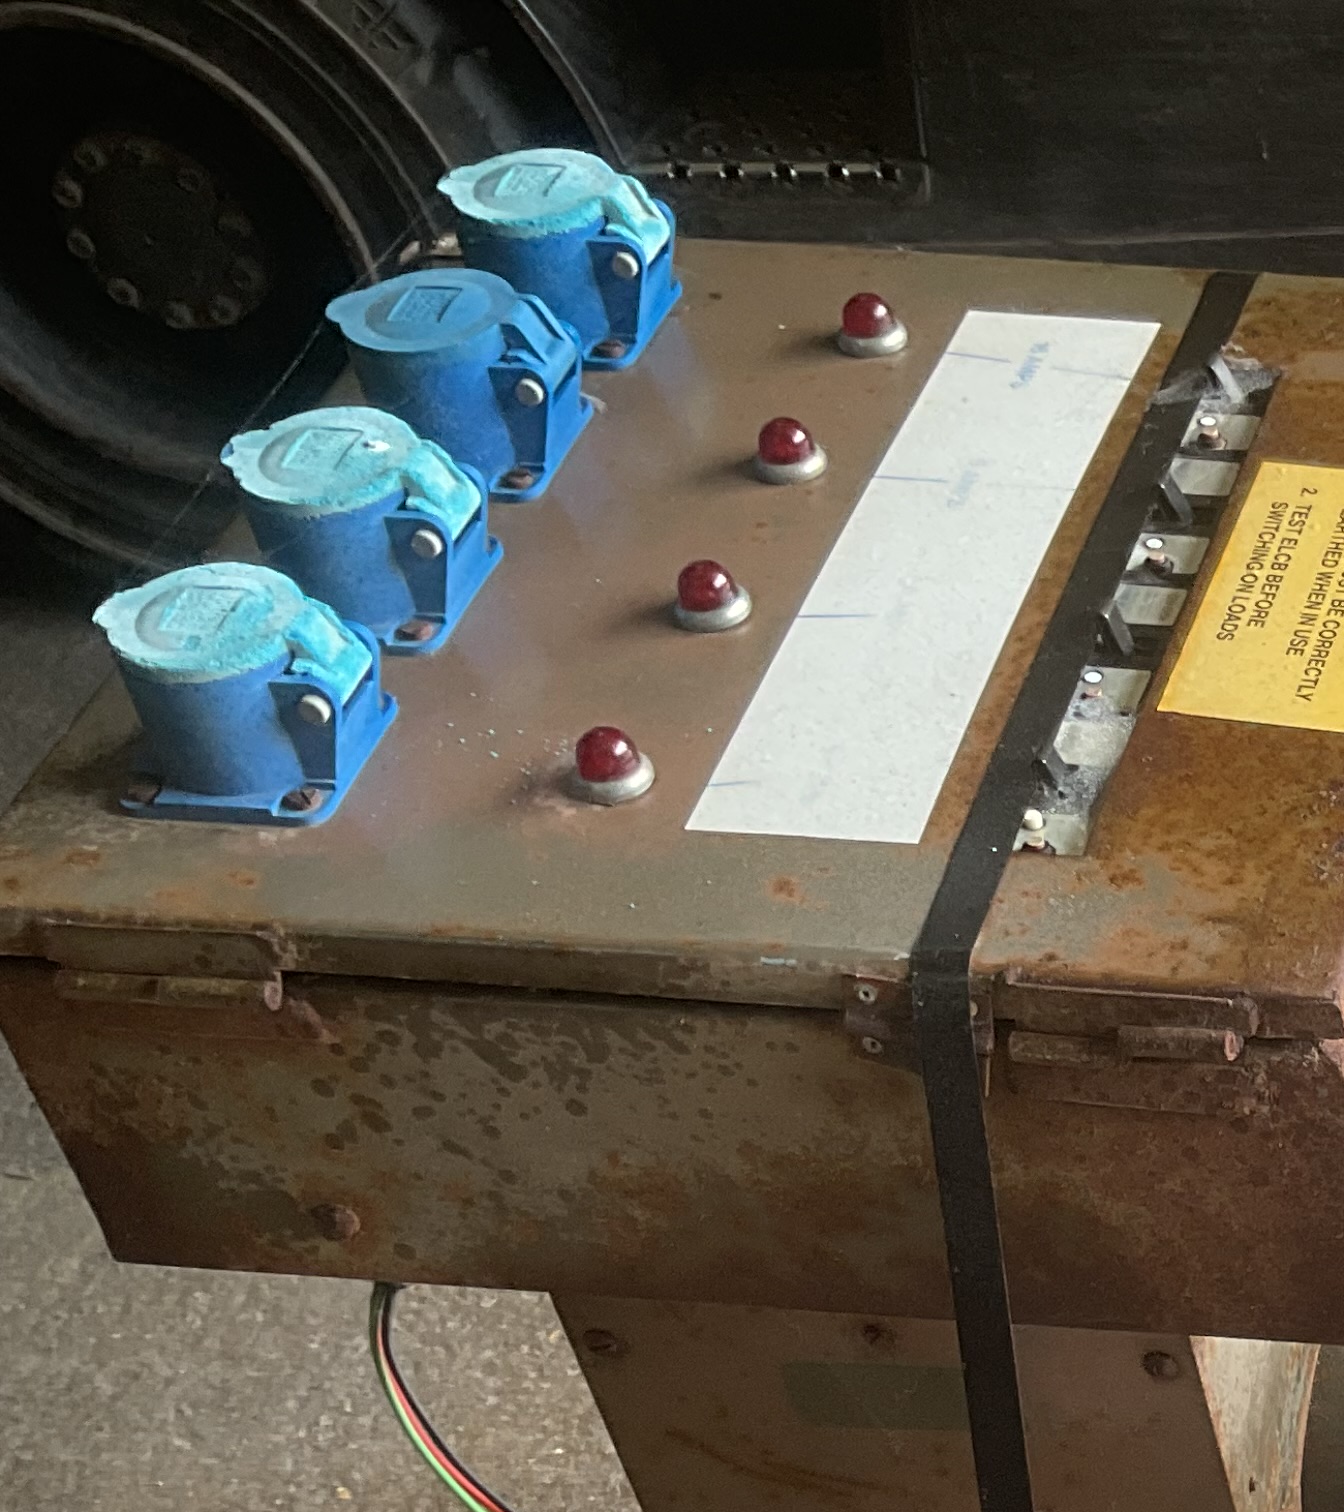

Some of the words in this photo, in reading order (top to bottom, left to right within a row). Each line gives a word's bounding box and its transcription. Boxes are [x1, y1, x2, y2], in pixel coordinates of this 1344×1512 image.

[1245, 501, 1289, 571] SWITCHING
[1285, 504, 1313, 536] TEST
[1270, 537, 1299, 571] ELCB
[1235, 573, 1259, 594] ON
[1246, 574, 1284, 629] BEFORE
[1303, 571, 1336, 611] WHEN
[1215, 595, 1251, 641] LOADS
[1296, 611, 1319, 627] IN
[1285, 629, 1313, 657] USE
[1294, 619, 1341, 702] CORRECTLY
